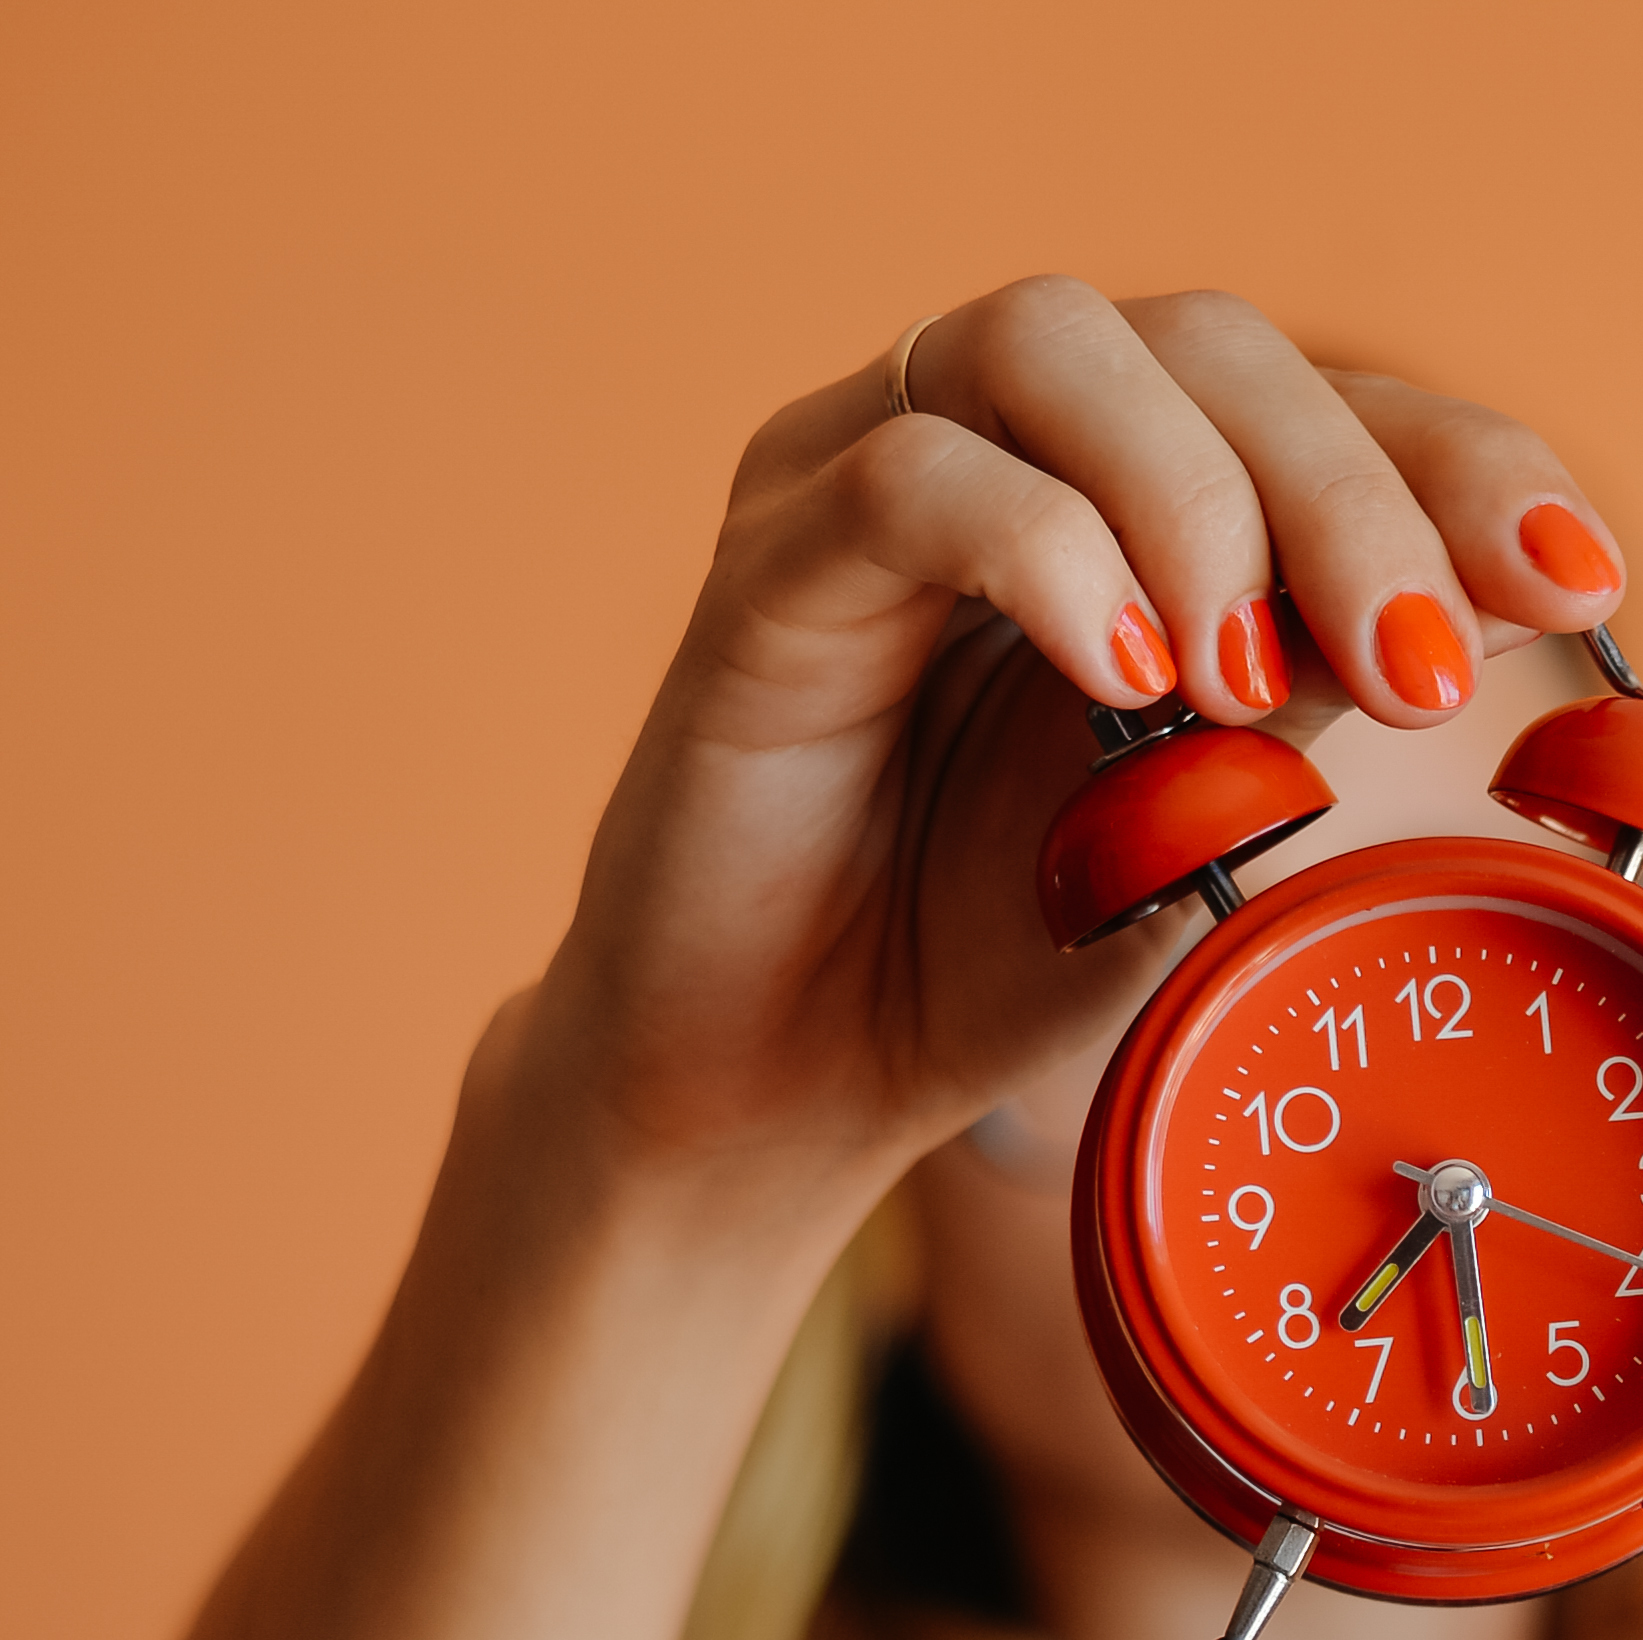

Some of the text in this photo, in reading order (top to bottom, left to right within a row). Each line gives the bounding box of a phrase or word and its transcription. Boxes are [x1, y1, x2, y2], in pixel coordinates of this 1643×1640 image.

[1312, 1005, 1369, 1070] 11
[1395, 974, 1473, 1041] 12
[1525, 992, 1553, 1055] 1
[1242, 1086, 1341, 1155] 10
[1228, 1185, 1275, 1250] 9
[1278, 1284, 1321, 1350] 8
[1354, 1337, 1395, 1404] 7
[1546, 1320, 1590, 1386] 5
